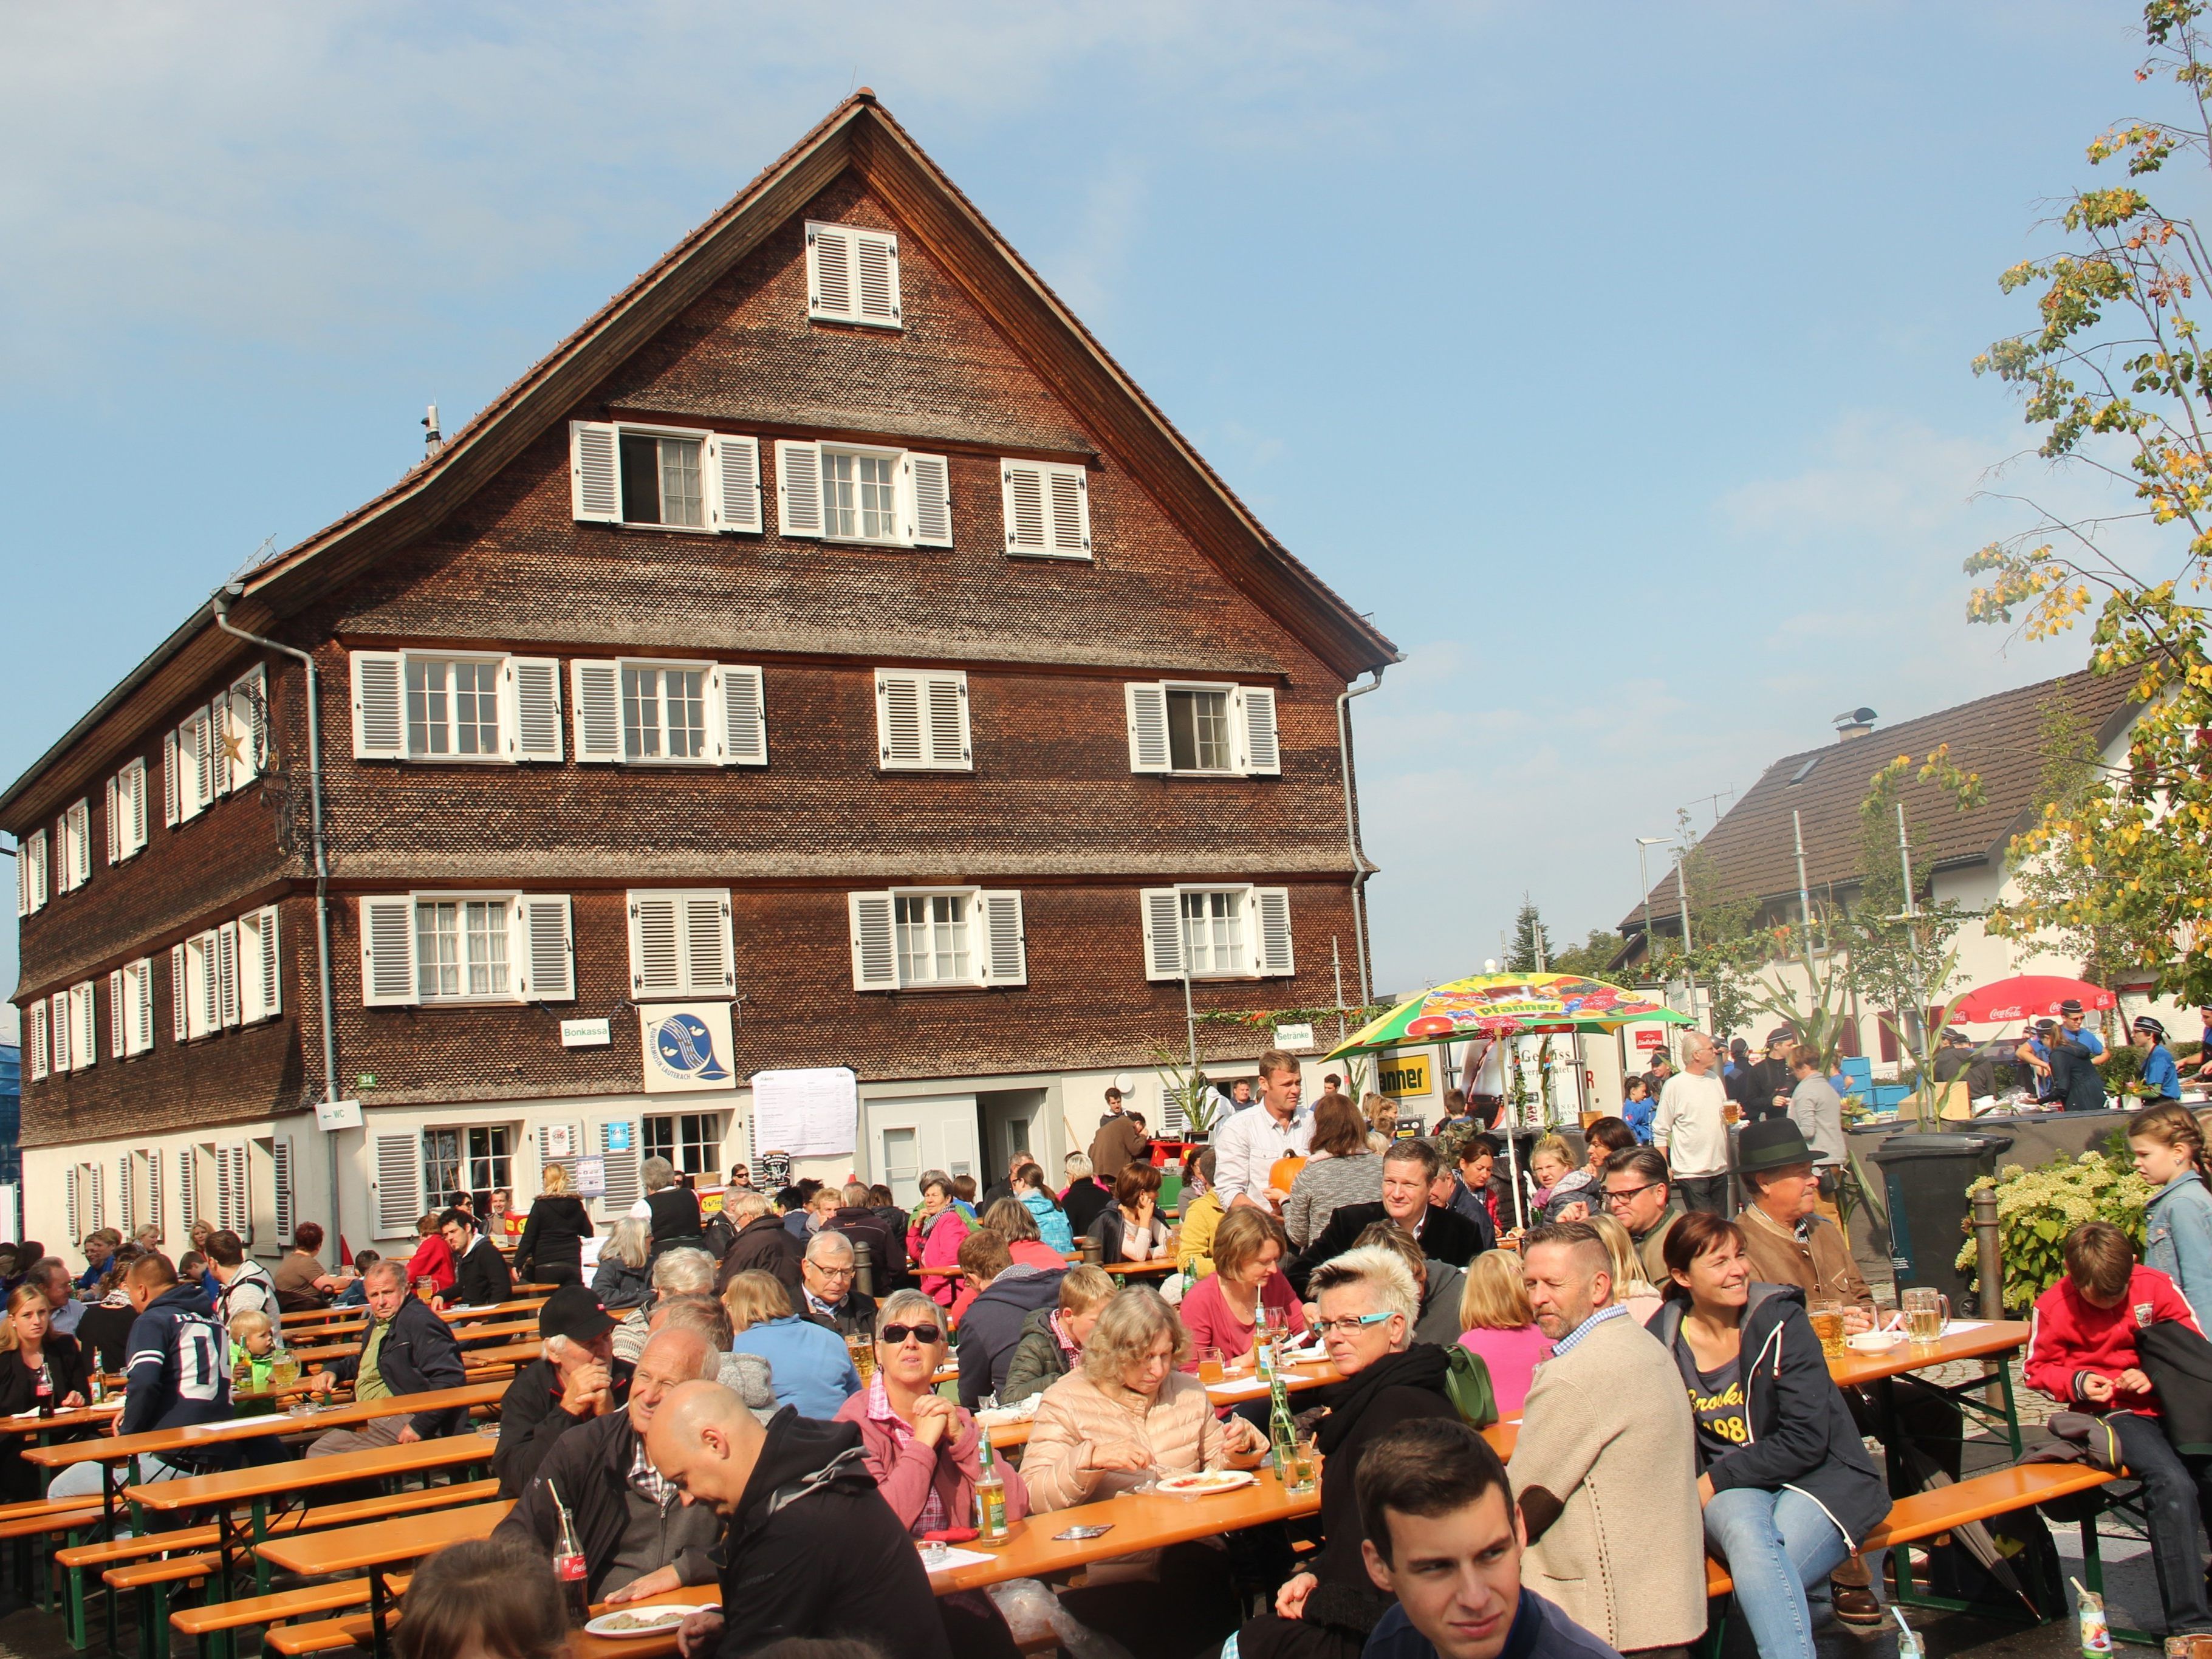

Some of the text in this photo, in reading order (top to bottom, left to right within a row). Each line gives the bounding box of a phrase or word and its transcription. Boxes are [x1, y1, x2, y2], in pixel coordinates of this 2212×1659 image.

[564, 1028, 607, 1036] Bonkassa
[1277, 1031, 1309, 1040] Getränke
[649, 1027, 691, 1079] BÜRGERMUSIK LAUTERACH
[333, 1109, 345, 1118] WC
